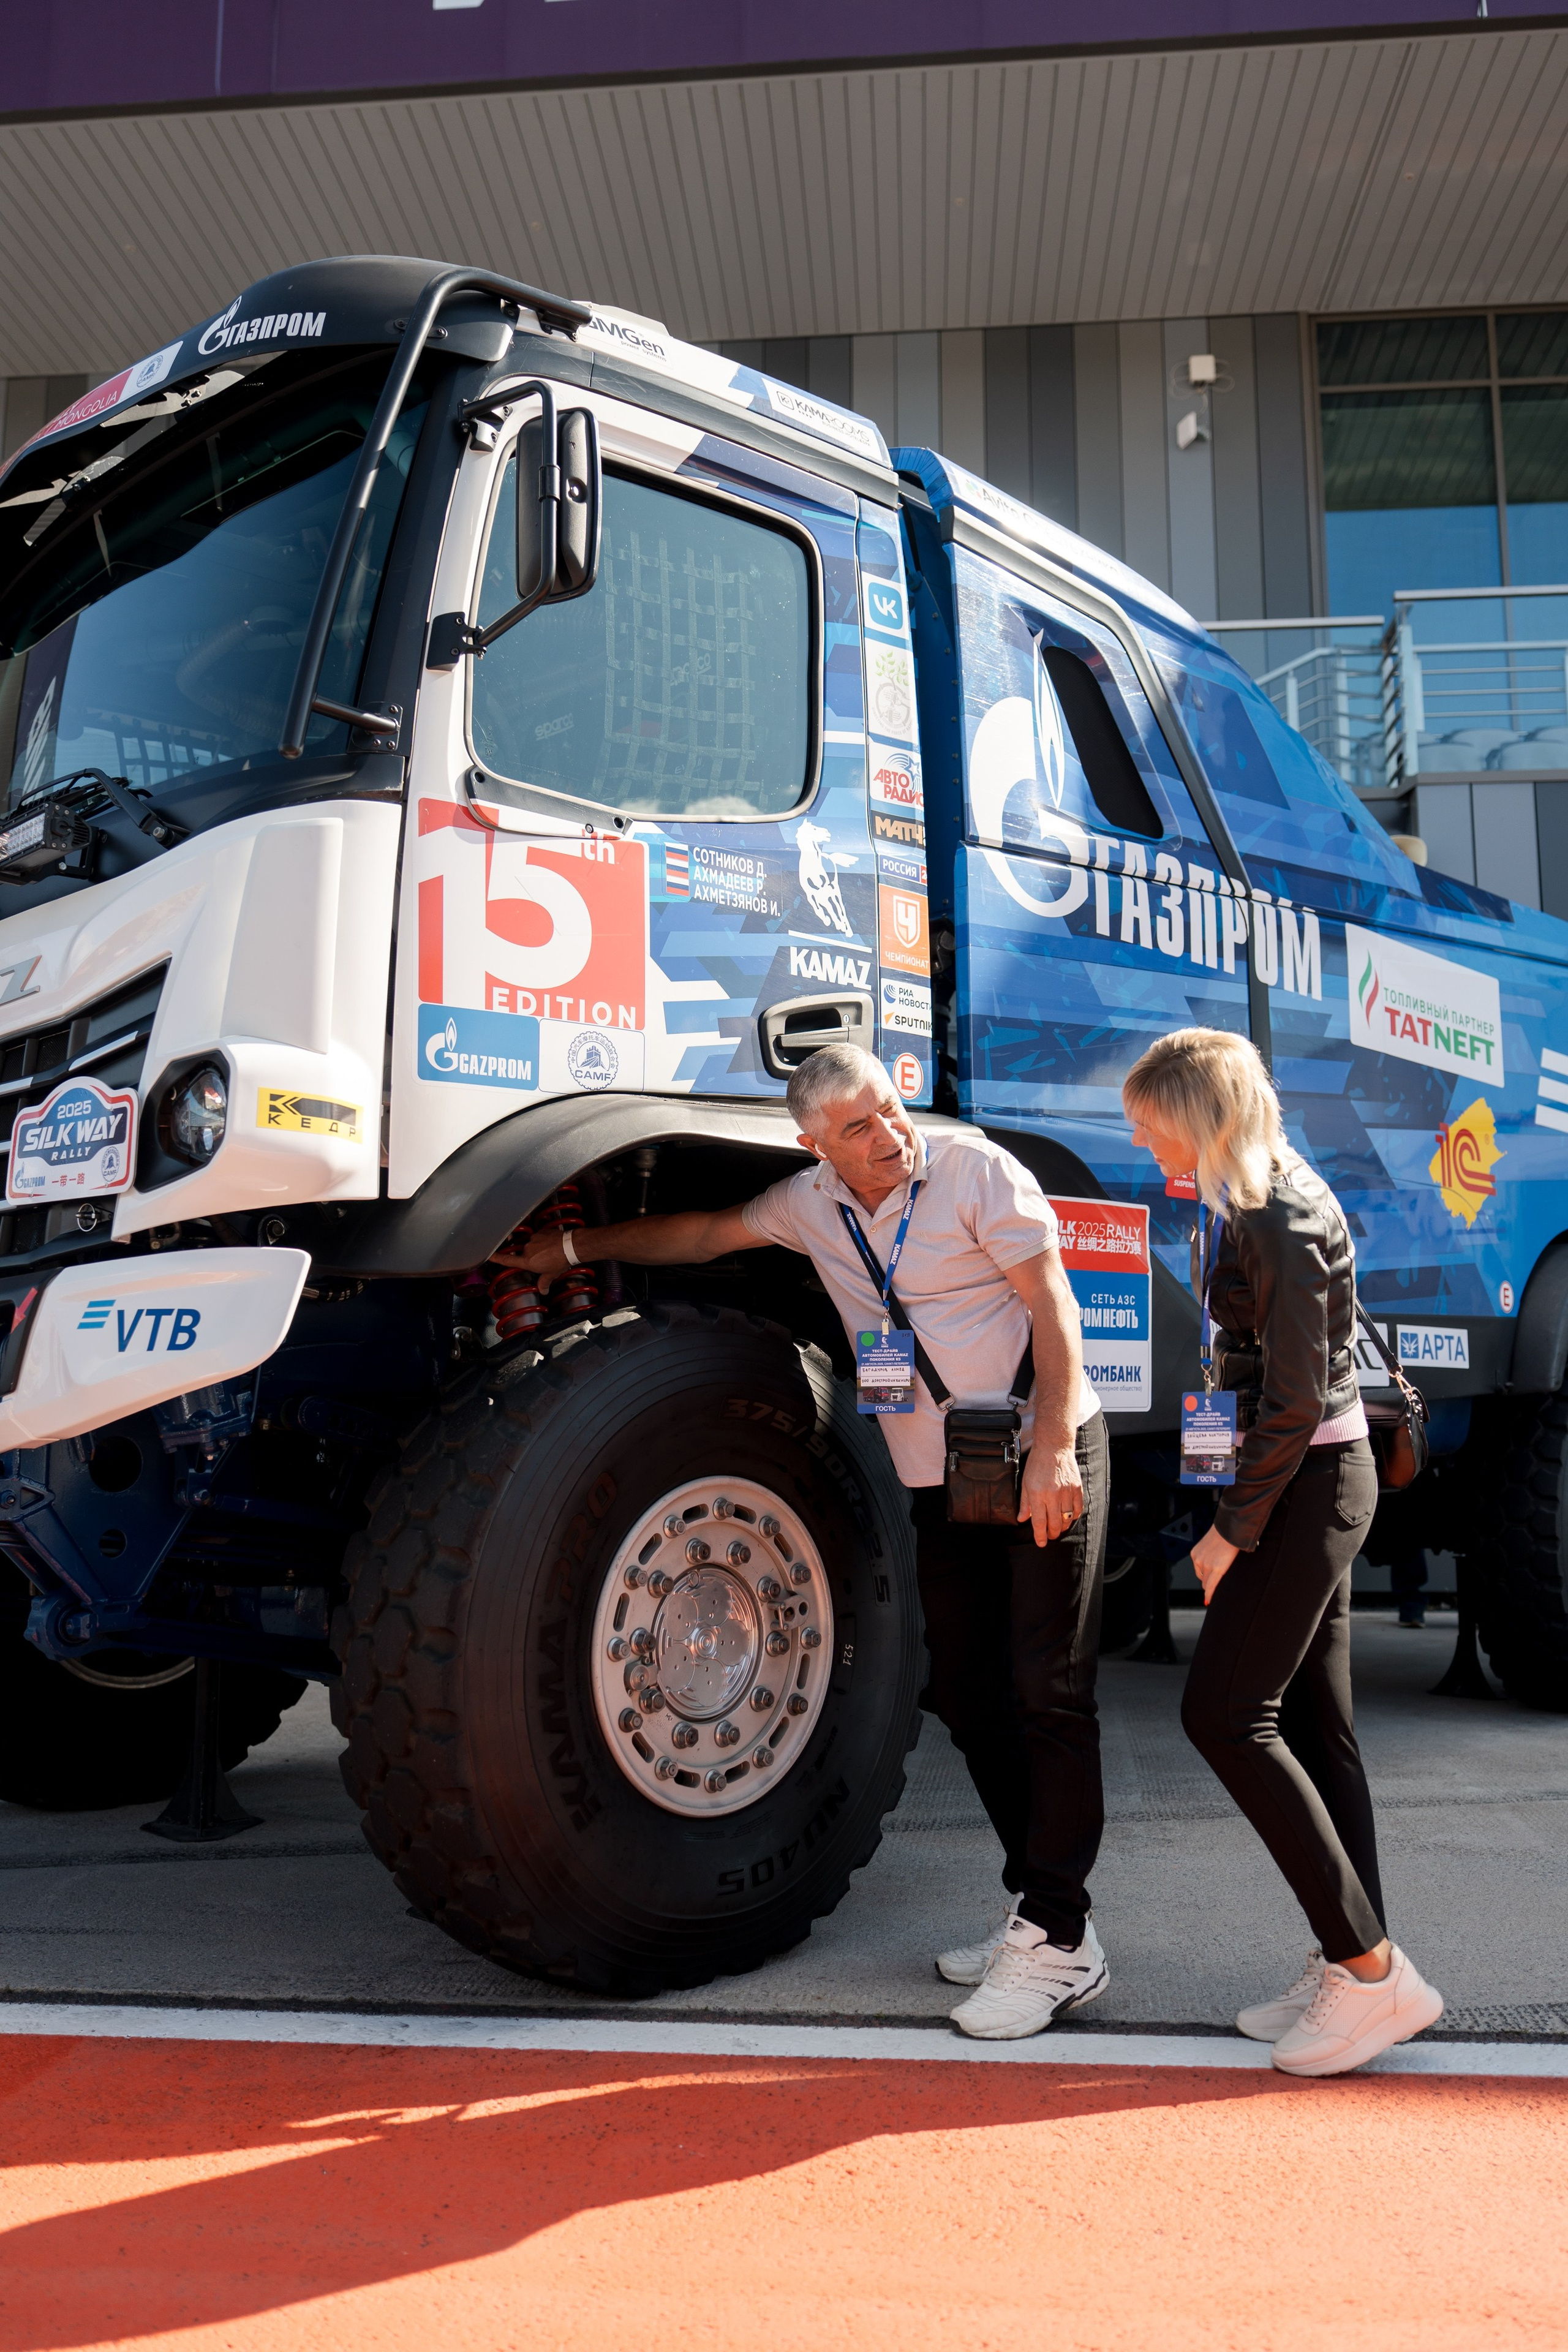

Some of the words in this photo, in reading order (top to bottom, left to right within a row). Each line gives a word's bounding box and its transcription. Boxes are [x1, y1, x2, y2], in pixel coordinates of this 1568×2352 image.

[225, 312, 326, 348] ГАЗПРОМ
[621, 341, 639, 350] power
[642, 350, 667, 362] systems
[53, 390, 118, 430] MONGOLIA
[873, 768, 910, 788] АВТО
[884, 784, 924, 807] РАДИО
[693, 846, 754, 875] СОТНИКОВ
[756, 861, 767, 880] Д.
[883, 858, 918, 878] РОССИЯ
[921, 869, 927, 881] 2
[693, 865, 754, 893] АХМАДЕЕВ
[756, 878, 766, 896] Р.
[694, 884, 768, 914] АХМЕТЗЯНОВ
[770, 900, 781, 917] И.
[1092, 834, 1322, 1002] ГАЗПРОМ
[790, 946, 872, 991] KAMAZ
[885, 951, 930, 970] ЧЕМПИОНАТ
[899, 987, 914, 997] РИА
[492, 986, 636, 1030] EDITION
[1384, 987, 1449, 1022] ТОПЛИВНЫЙ
[1452, 1011, 1494, 1036] ПАРТНЕР
[1384, 1006, 1495, 1066] TATNEFT
[459, 1054, 532, 1081] GAZPROM
[575, 1069, 611, 1081] CAMF
[57, 1099, 92, 1120] 2025
[23, 1122, 75, 1152] SILK
[77, 1113, 124, 1144] WAY
[268, 1113, 356, 1137] КЕДР
[51, 1147, 91, 1161] RALLY
[23, 1175, 46, 1189] GAZPROM
[51, 1172, 85, 1188] 一带一路
[903, 1199, 913, 1220] KAMAZ
[846, 1212, 858, 1232] KAMAZ
[1077, 1221, 1106, 1237] 2025
[1106, 1224, 1141, 1240] RALLY
[890, 1243, 901, 1265] KAMAZ
[1077, 1236, 1142, 1256] 丝绸之路拉力赛
[1091, 1293, 1115, 1305] СЕТЬ
[1117, 1294, 1136, 1305] АЗС
[116, 1308, 201, 1352] VTB
[1422, 1333, 1466, 1362] АРТА
